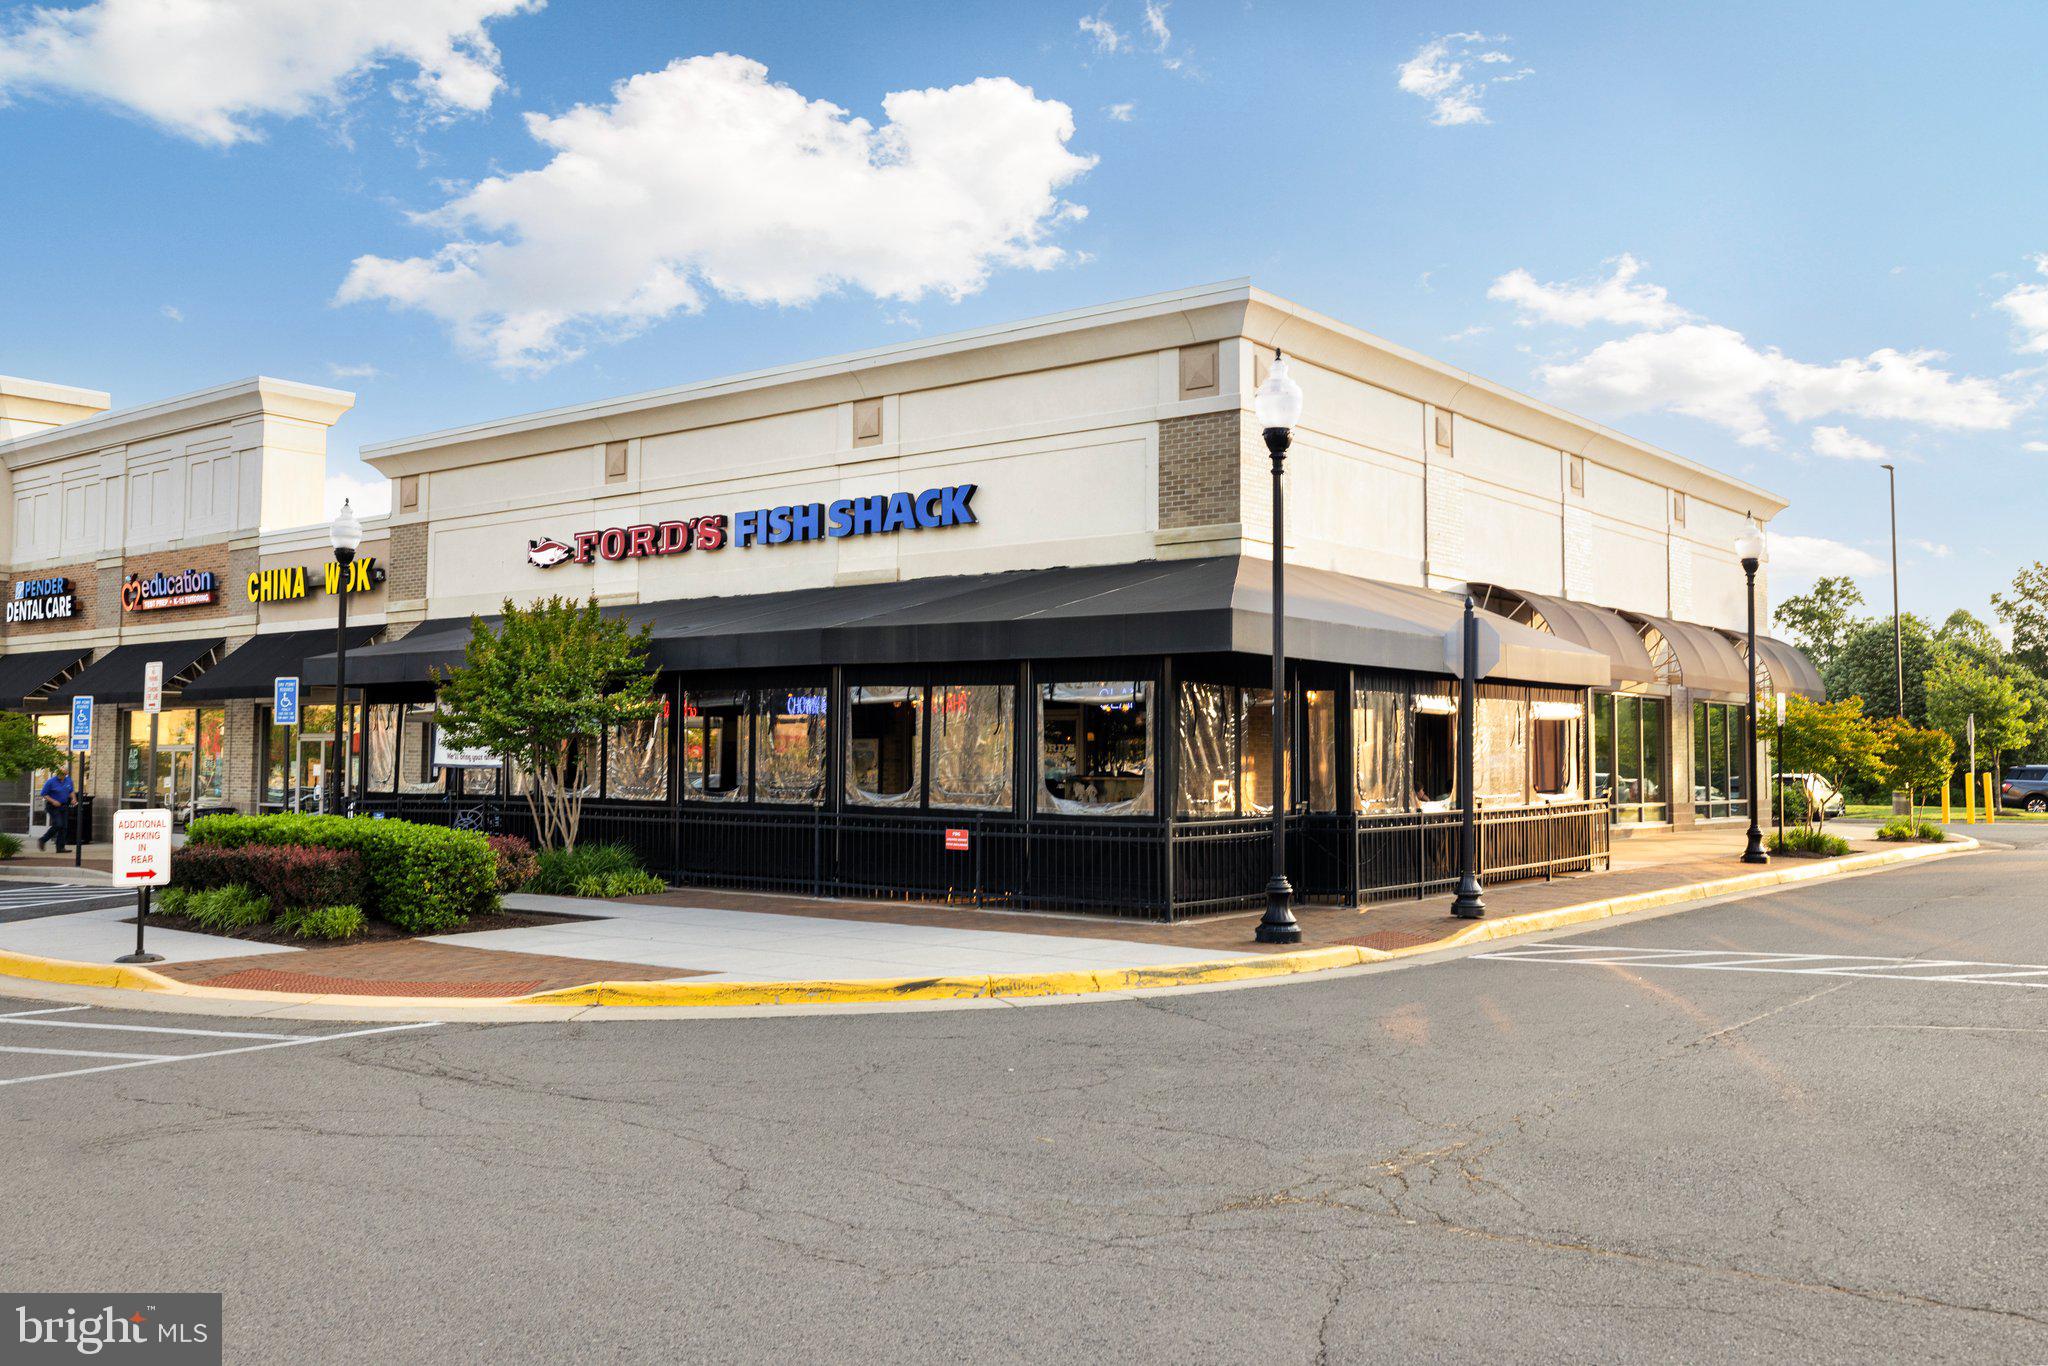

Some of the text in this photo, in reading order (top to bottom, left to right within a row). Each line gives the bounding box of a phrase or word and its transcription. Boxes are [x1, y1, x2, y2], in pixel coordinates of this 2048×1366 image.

[574, 484, 979, 564] FORD'S FISH SHACK
[25, 577, 64, 597] PENDER
[141, 569, 211, 598] education
[247, 566, 305, 602] CHINA
[6, 595, 72, 623] DENTAL CARE
[118, 820, 167, 829] ADDITIONAL
[124, 832, 161, 840] PARKING
[138, 844, 147, 852] IN
[131, 855, 153, 864] REAR
